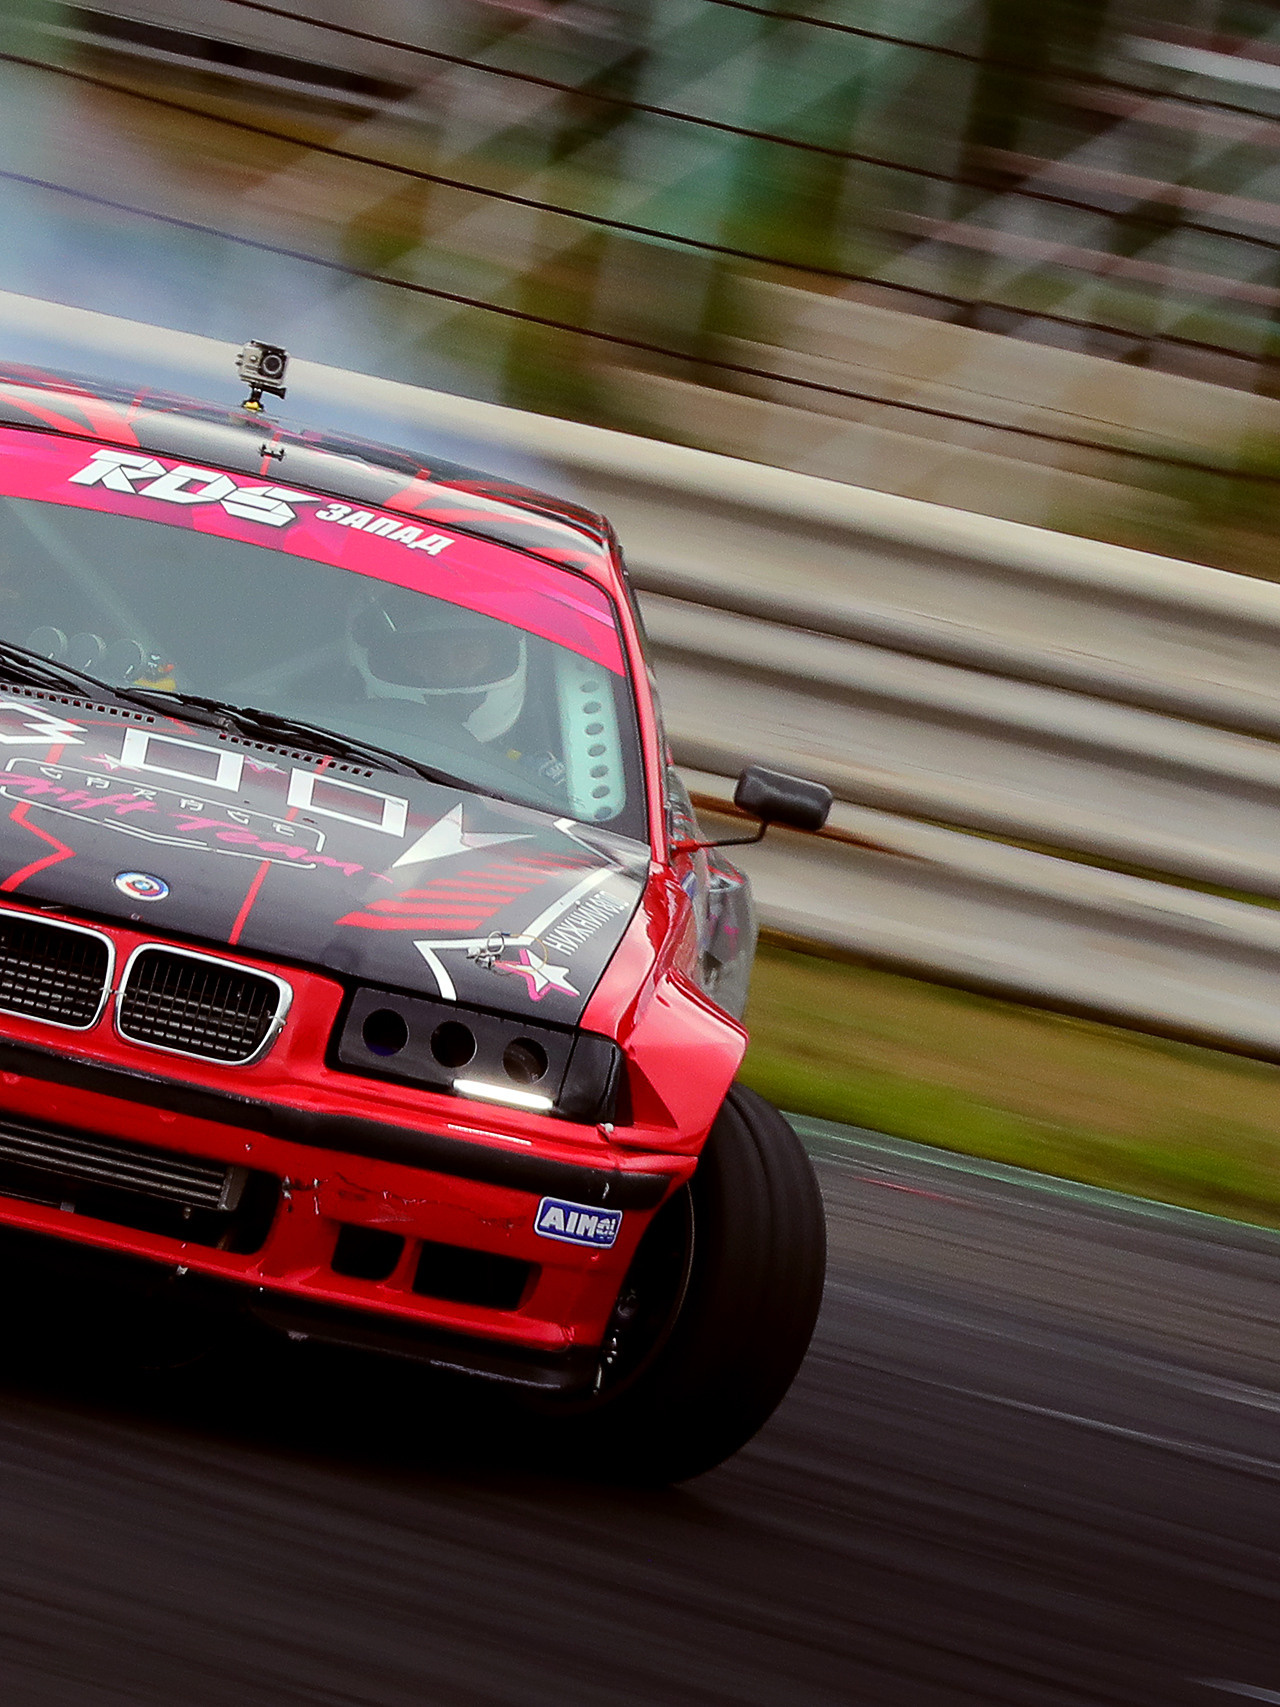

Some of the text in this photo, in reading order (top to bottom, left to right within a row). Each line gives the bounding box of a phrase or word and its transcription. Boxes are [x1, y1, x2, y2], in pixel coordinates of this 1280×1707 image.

[68, 449, 322, 528] RDS
[315, 502, 455, 556] ЗАПАД
[39, 765, 296, 837] GARAGE
[167, 812, 365, 877] Team
